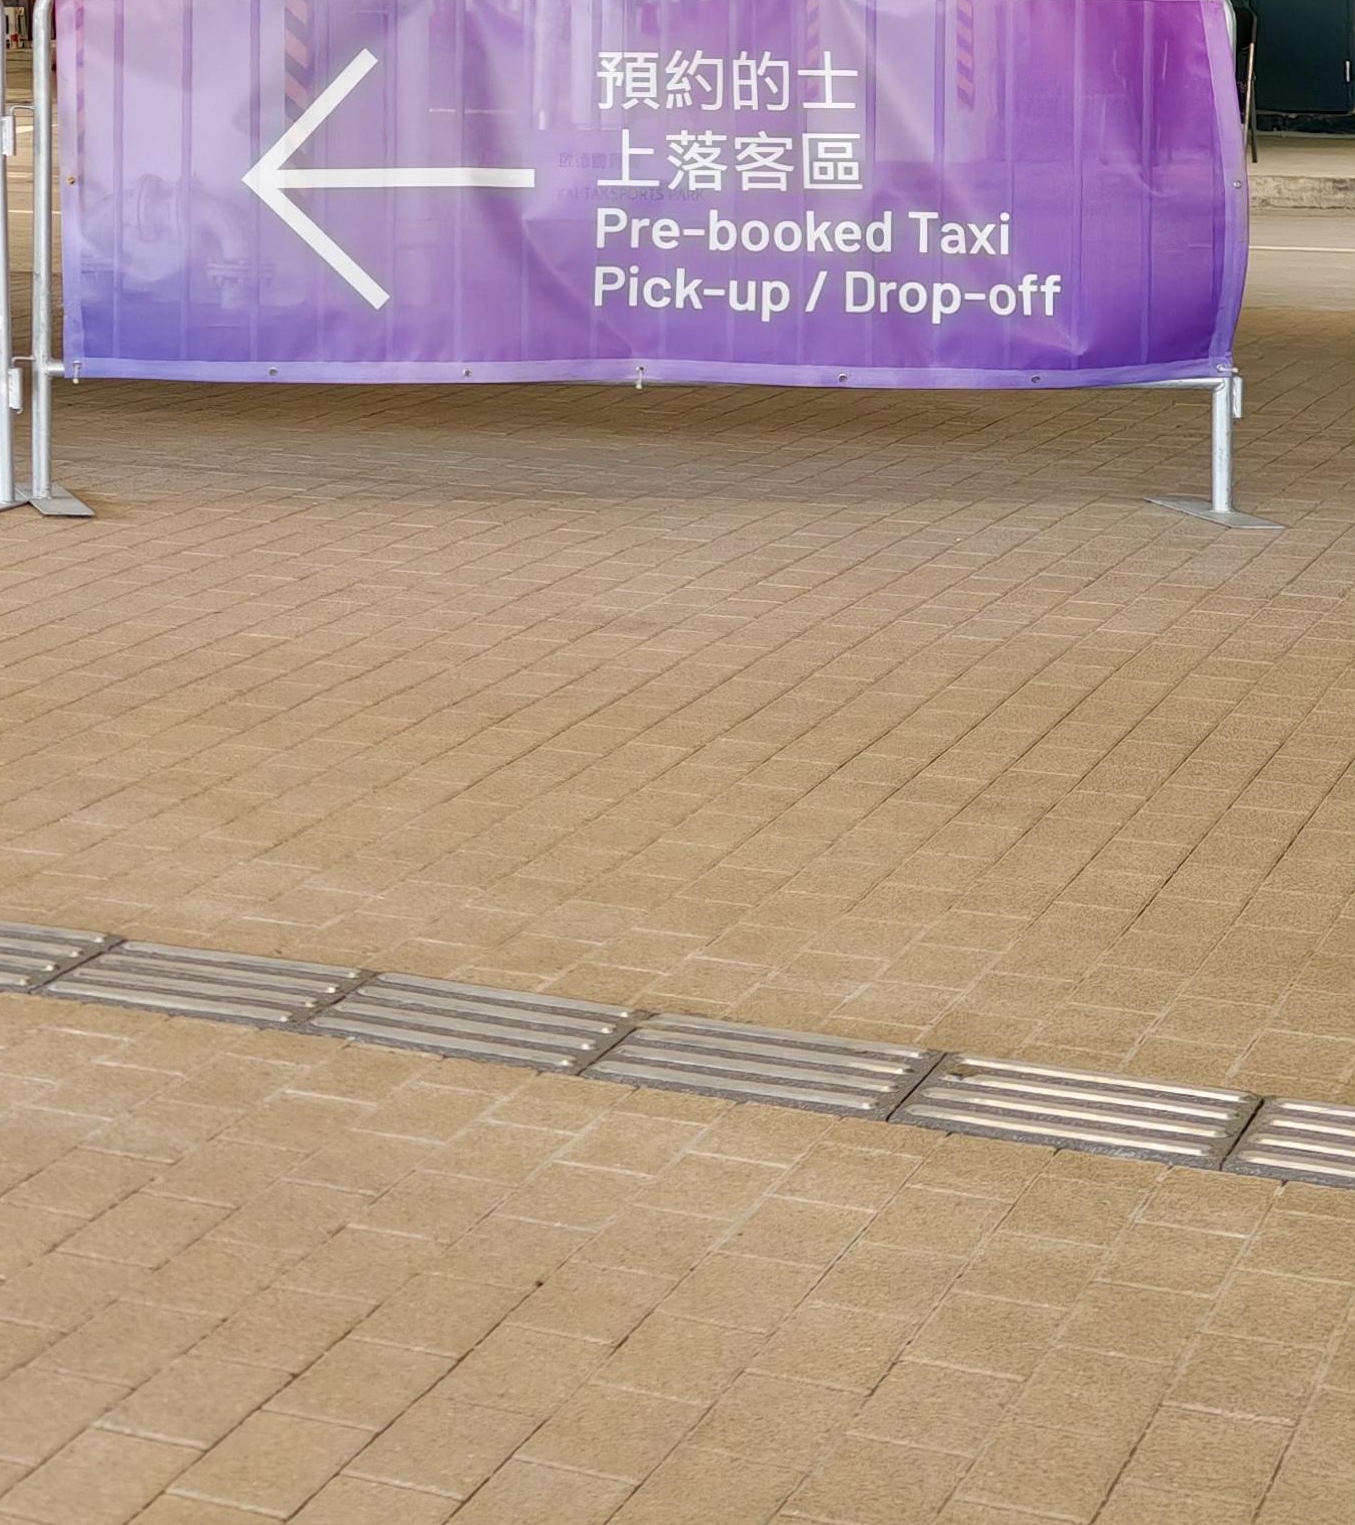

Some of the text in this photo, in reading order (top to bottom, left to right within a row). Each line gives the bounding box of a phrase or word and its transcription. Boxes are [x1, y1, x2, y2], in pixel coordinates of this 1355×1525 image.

[596, 49, 859, 112] 預約的士
[596, 128, 864, 192] 上落客區
[595, 207, 1013, 256] Pre-booked Taxi
[593, 265, 1062, 325] Pick-up / Drop-off
